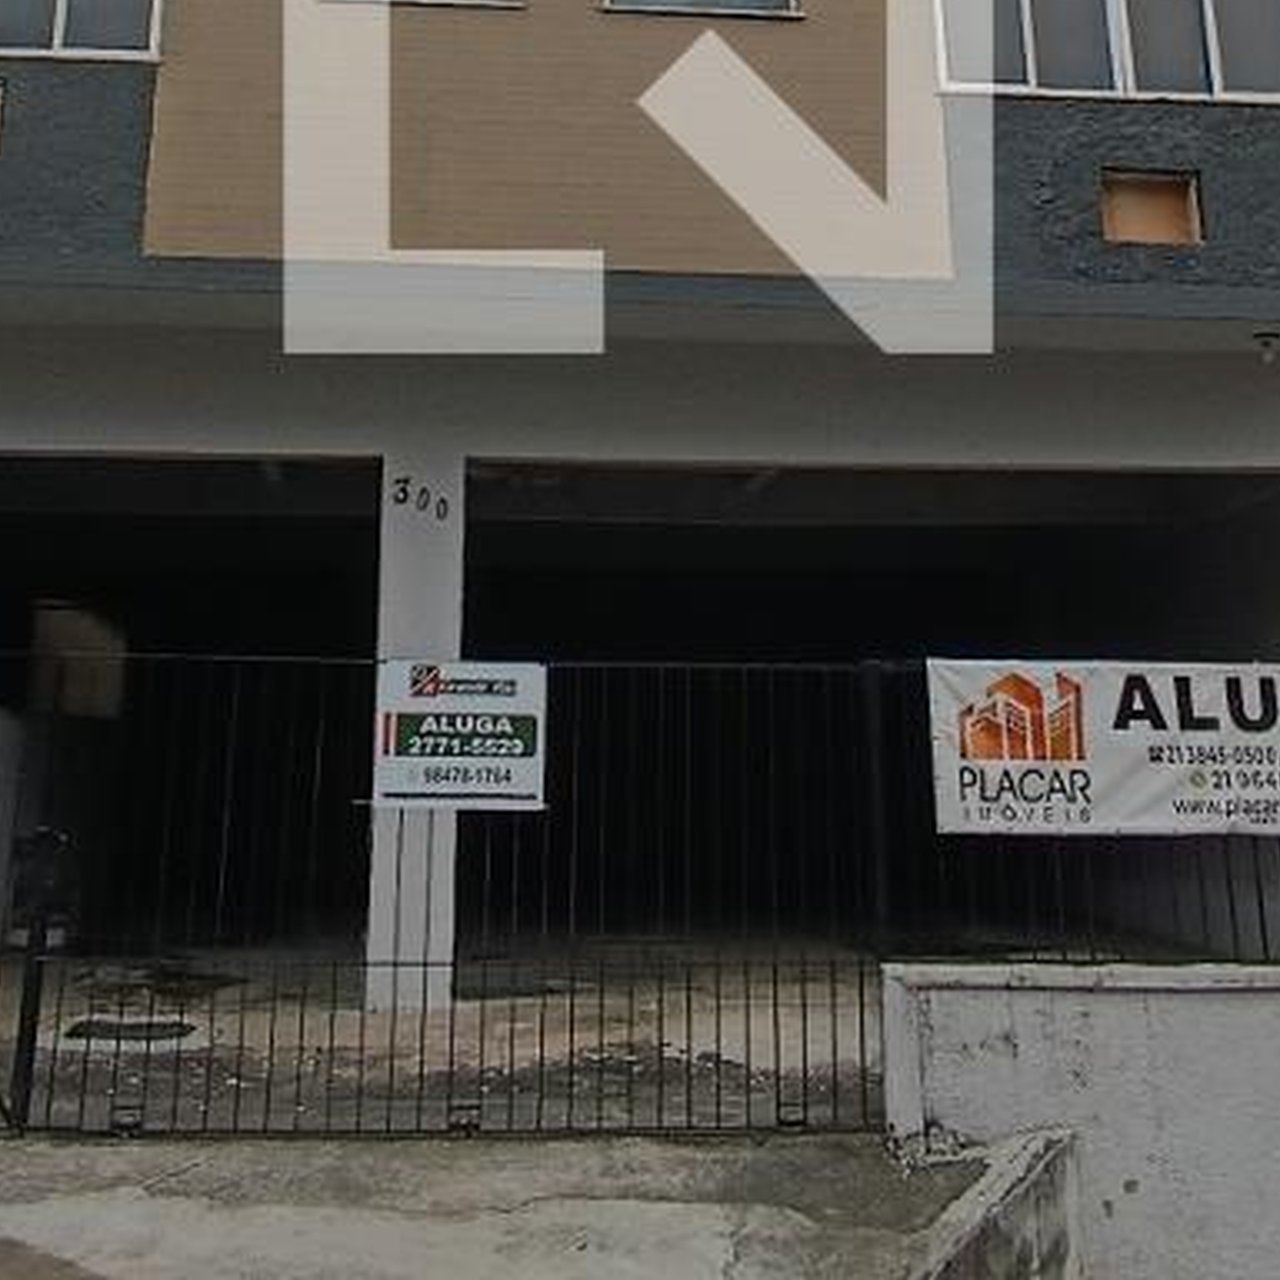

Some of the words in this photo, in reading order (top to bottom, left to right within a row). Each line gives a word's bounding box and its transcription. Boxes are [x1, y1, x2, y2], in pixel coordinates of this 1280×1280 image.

[394, 476, 449, 521] 300
[419, 715, 514, 735] ALUGA
[959, 766, 1092, 804] PLACAR
